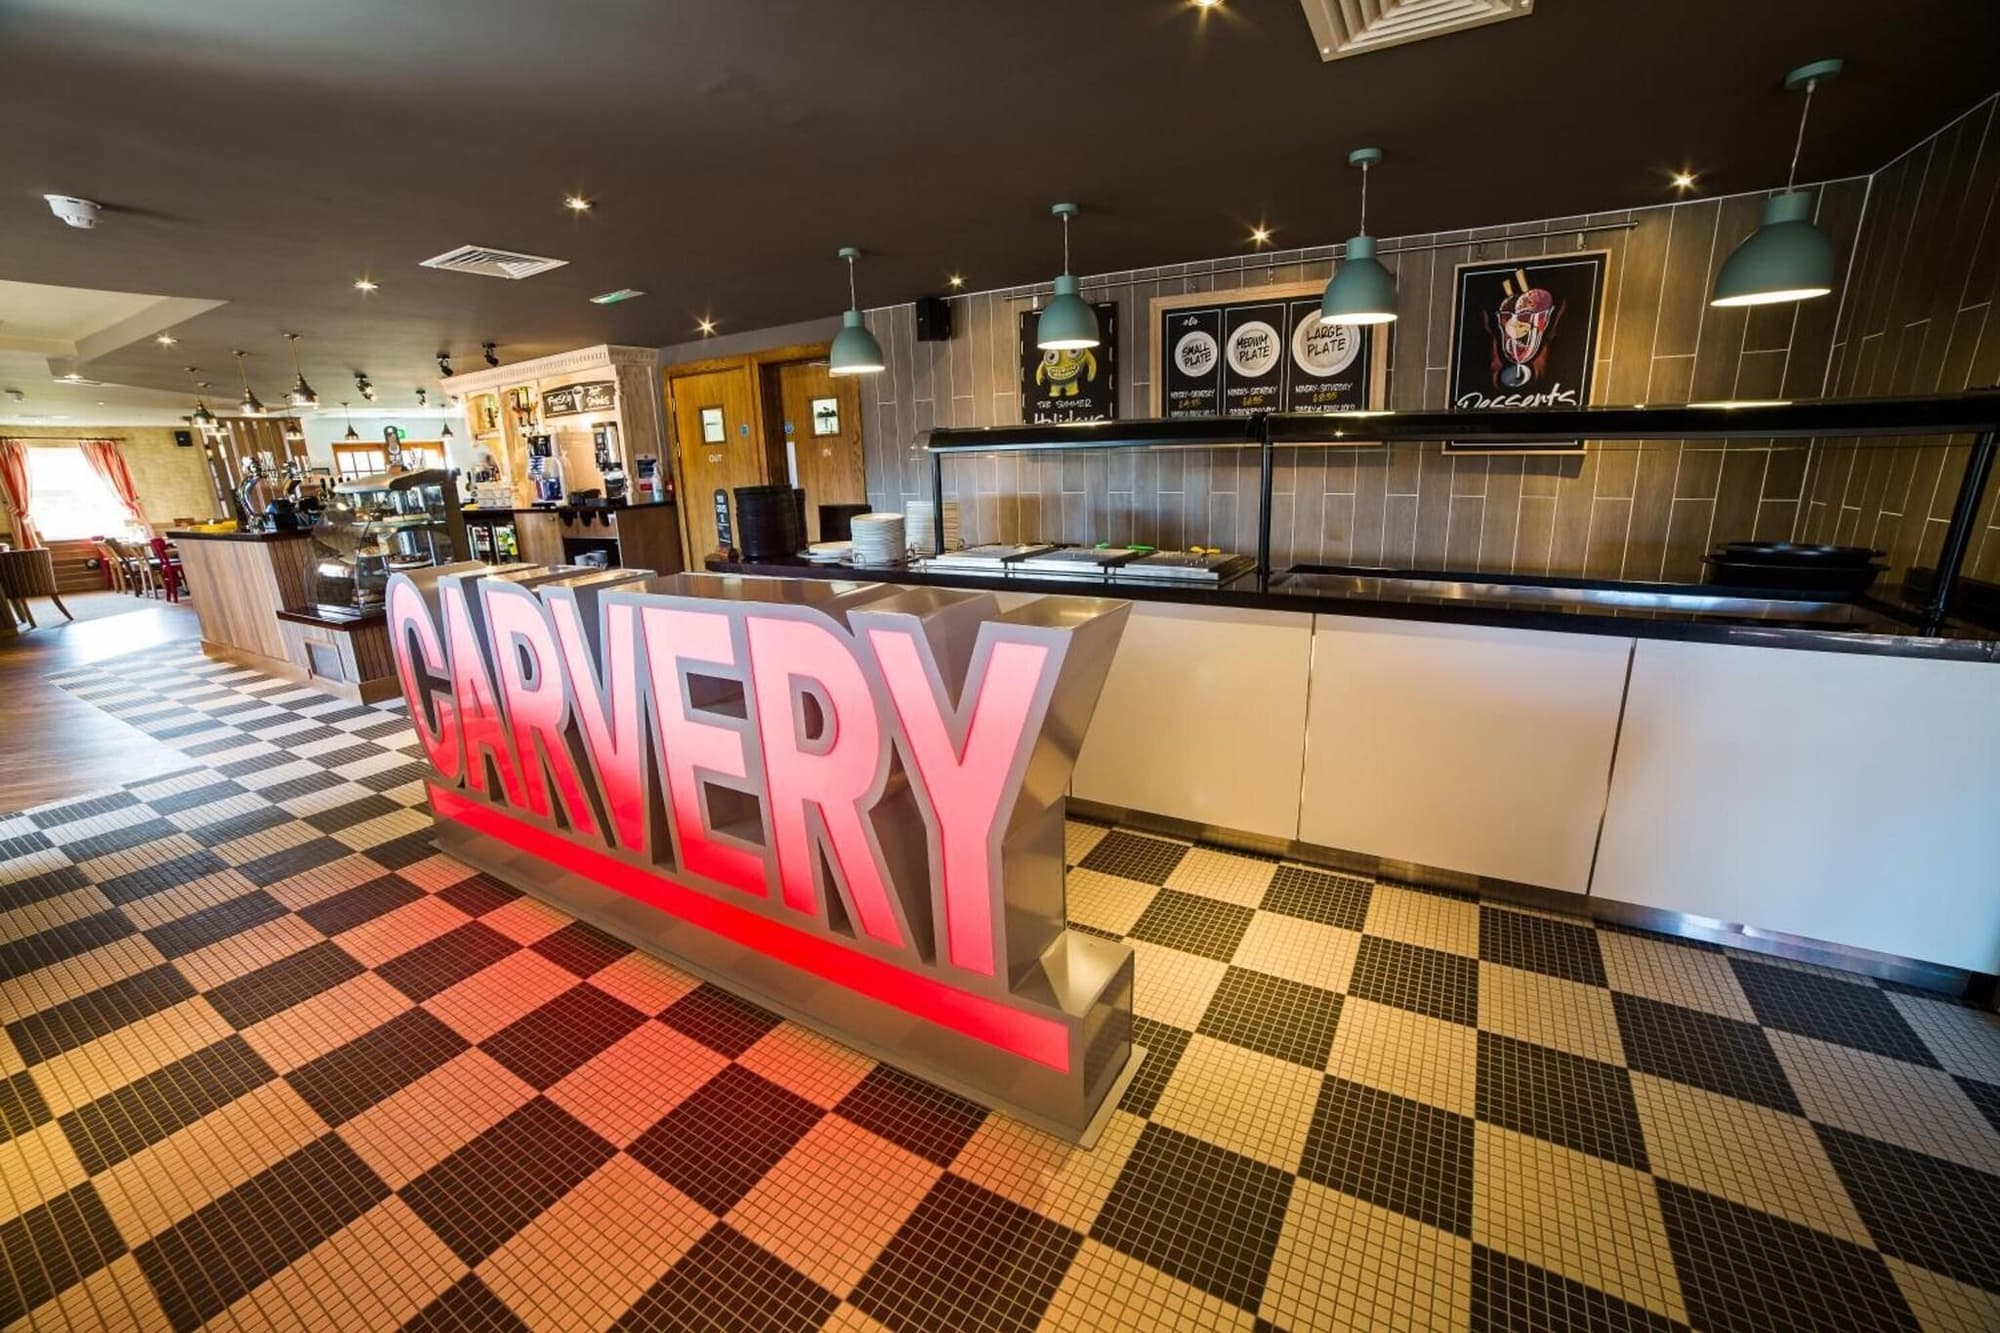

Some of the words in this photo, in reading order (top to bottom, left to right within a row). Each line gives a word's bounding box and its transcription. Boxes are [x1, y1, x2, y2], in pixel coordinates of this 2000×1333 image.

[1306, 324, 1344, 341] LARGE
[1183, 342, 1210, 358] SMALL
[1236, 335, 1269, 350] MEDIUM
[1307, 338, 1346, 358] PLATE
[1184, 351, 1212, 368] PLATE
[1239, 346, 1271, 362] PLATE
[1037, 401, 1052, 409] THE
[1055, 398, 1092, 409] SUMMER
[708, 454, 723, 464] OUT
[822, 448, 832, 457] IN
[387, 578, 1056, 980] CARVERY
